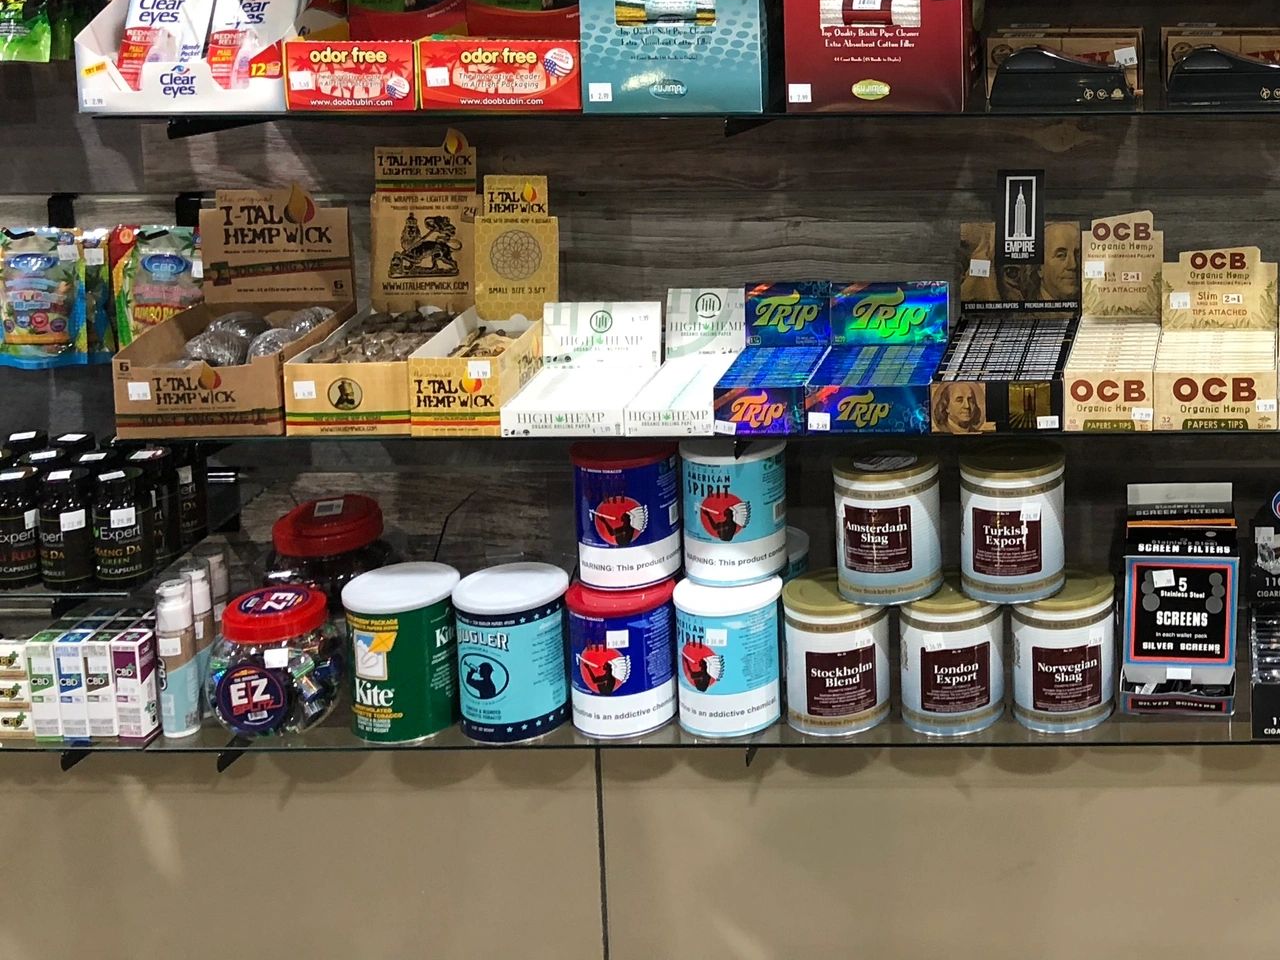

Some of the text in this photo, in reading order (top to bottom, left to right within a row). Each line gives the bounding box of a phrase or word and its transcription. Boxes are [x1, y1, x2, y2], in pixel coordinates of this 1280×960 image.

[139, 10, 180, 25] eyes
[309, 47, 388, 63] odor free
[460, 97, 544, 106] www.doobtubin.com
[411, 155, 440, 167] HEMP
[1092, 223, 1151, 241] OCB
[1004, 242, 1035, 253] EMPIRE
[1090, 242, 1154, 252] Organic Hemp
[1187, 420, 1217, 429] PAPERS
[1228, 420, 1244, 429] TIPS
[688, 483, 730, 499] SPIRIT
[846, 521, 908, 533] Amsterdam
[983, 525, 1028, 536] Turkish
[1138, 543, 1231, 554] SCREEN FILTERS
[811, 661, 873, 678] Stockholm
[933, 661, 979, 675] London
[355, 680, 393, 705] Kite
[711, 708, 744, 719] addictive
